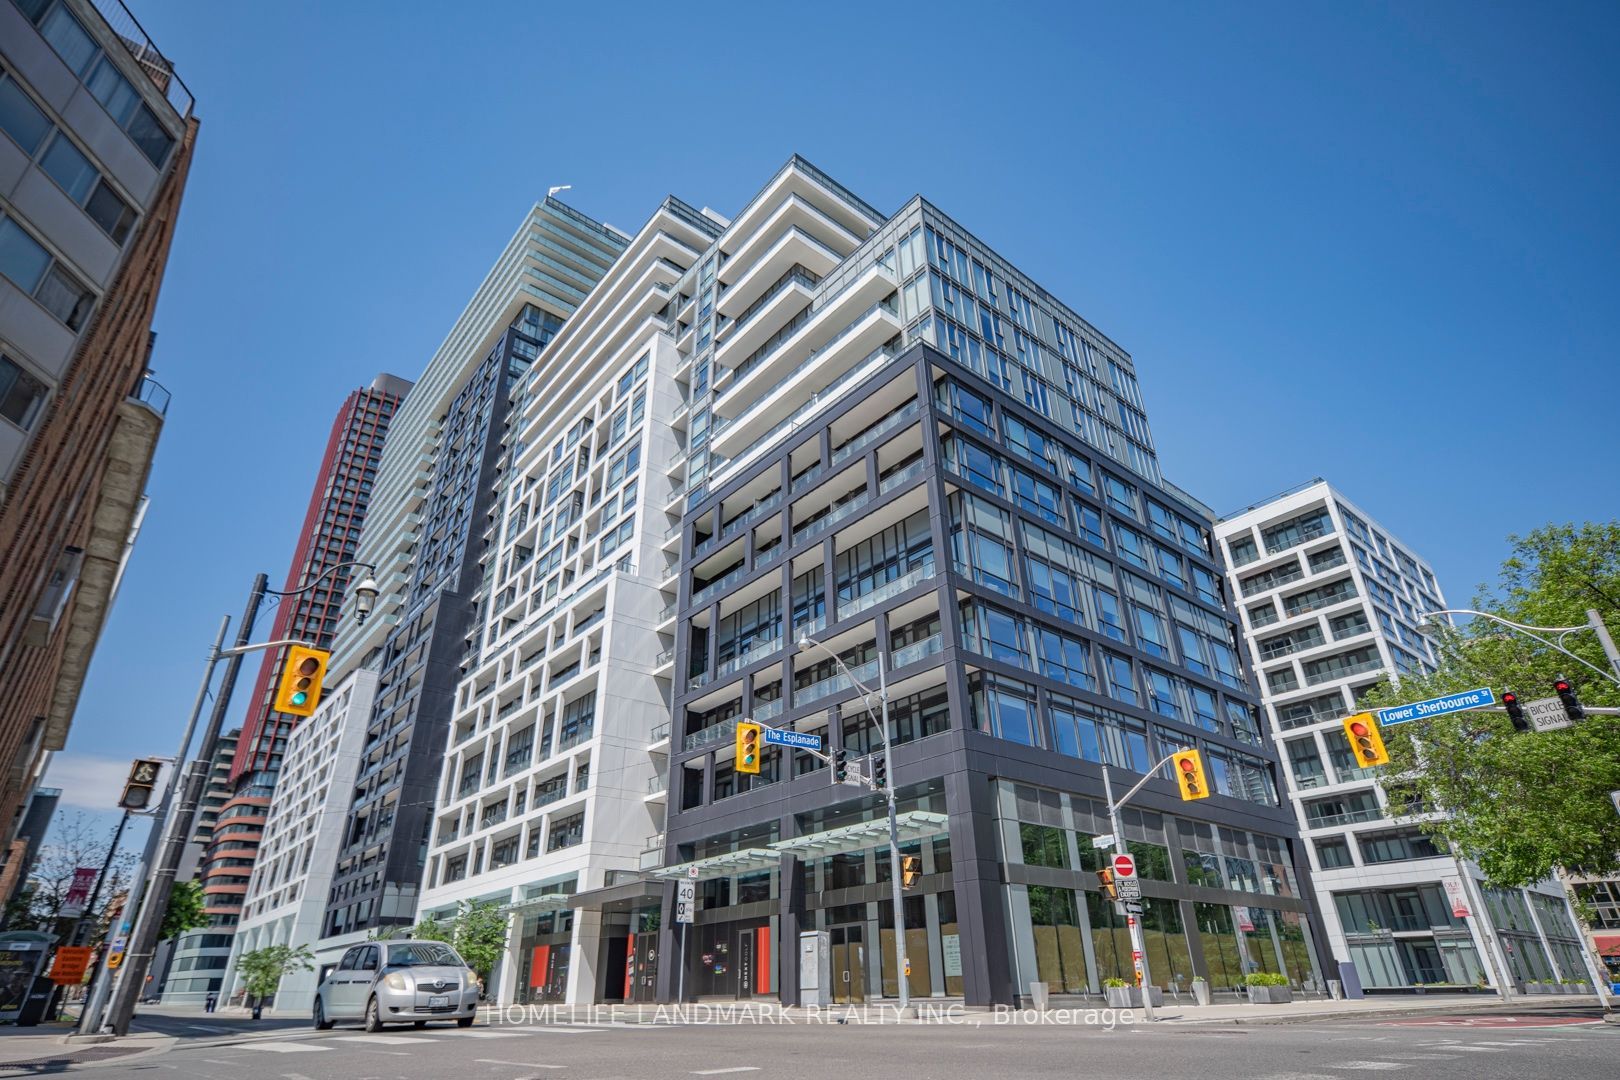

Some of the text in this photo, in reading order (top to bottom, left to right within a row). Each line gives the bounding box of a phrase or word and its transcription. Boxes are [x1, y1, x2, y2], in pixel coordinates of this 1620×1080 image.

[1383, 708, 1414, 722] Lower
[1416, 694, 1480, 715] Sherbourne
[1530, 700, 1565, 716] BICYCLE
[1536, 713, 1568, 727] SIGNAL
[767, 729, 819, 746] The Esplanade
[847, 765, 860, 774] CYCLE
[680, 888, 694, 899] 40
